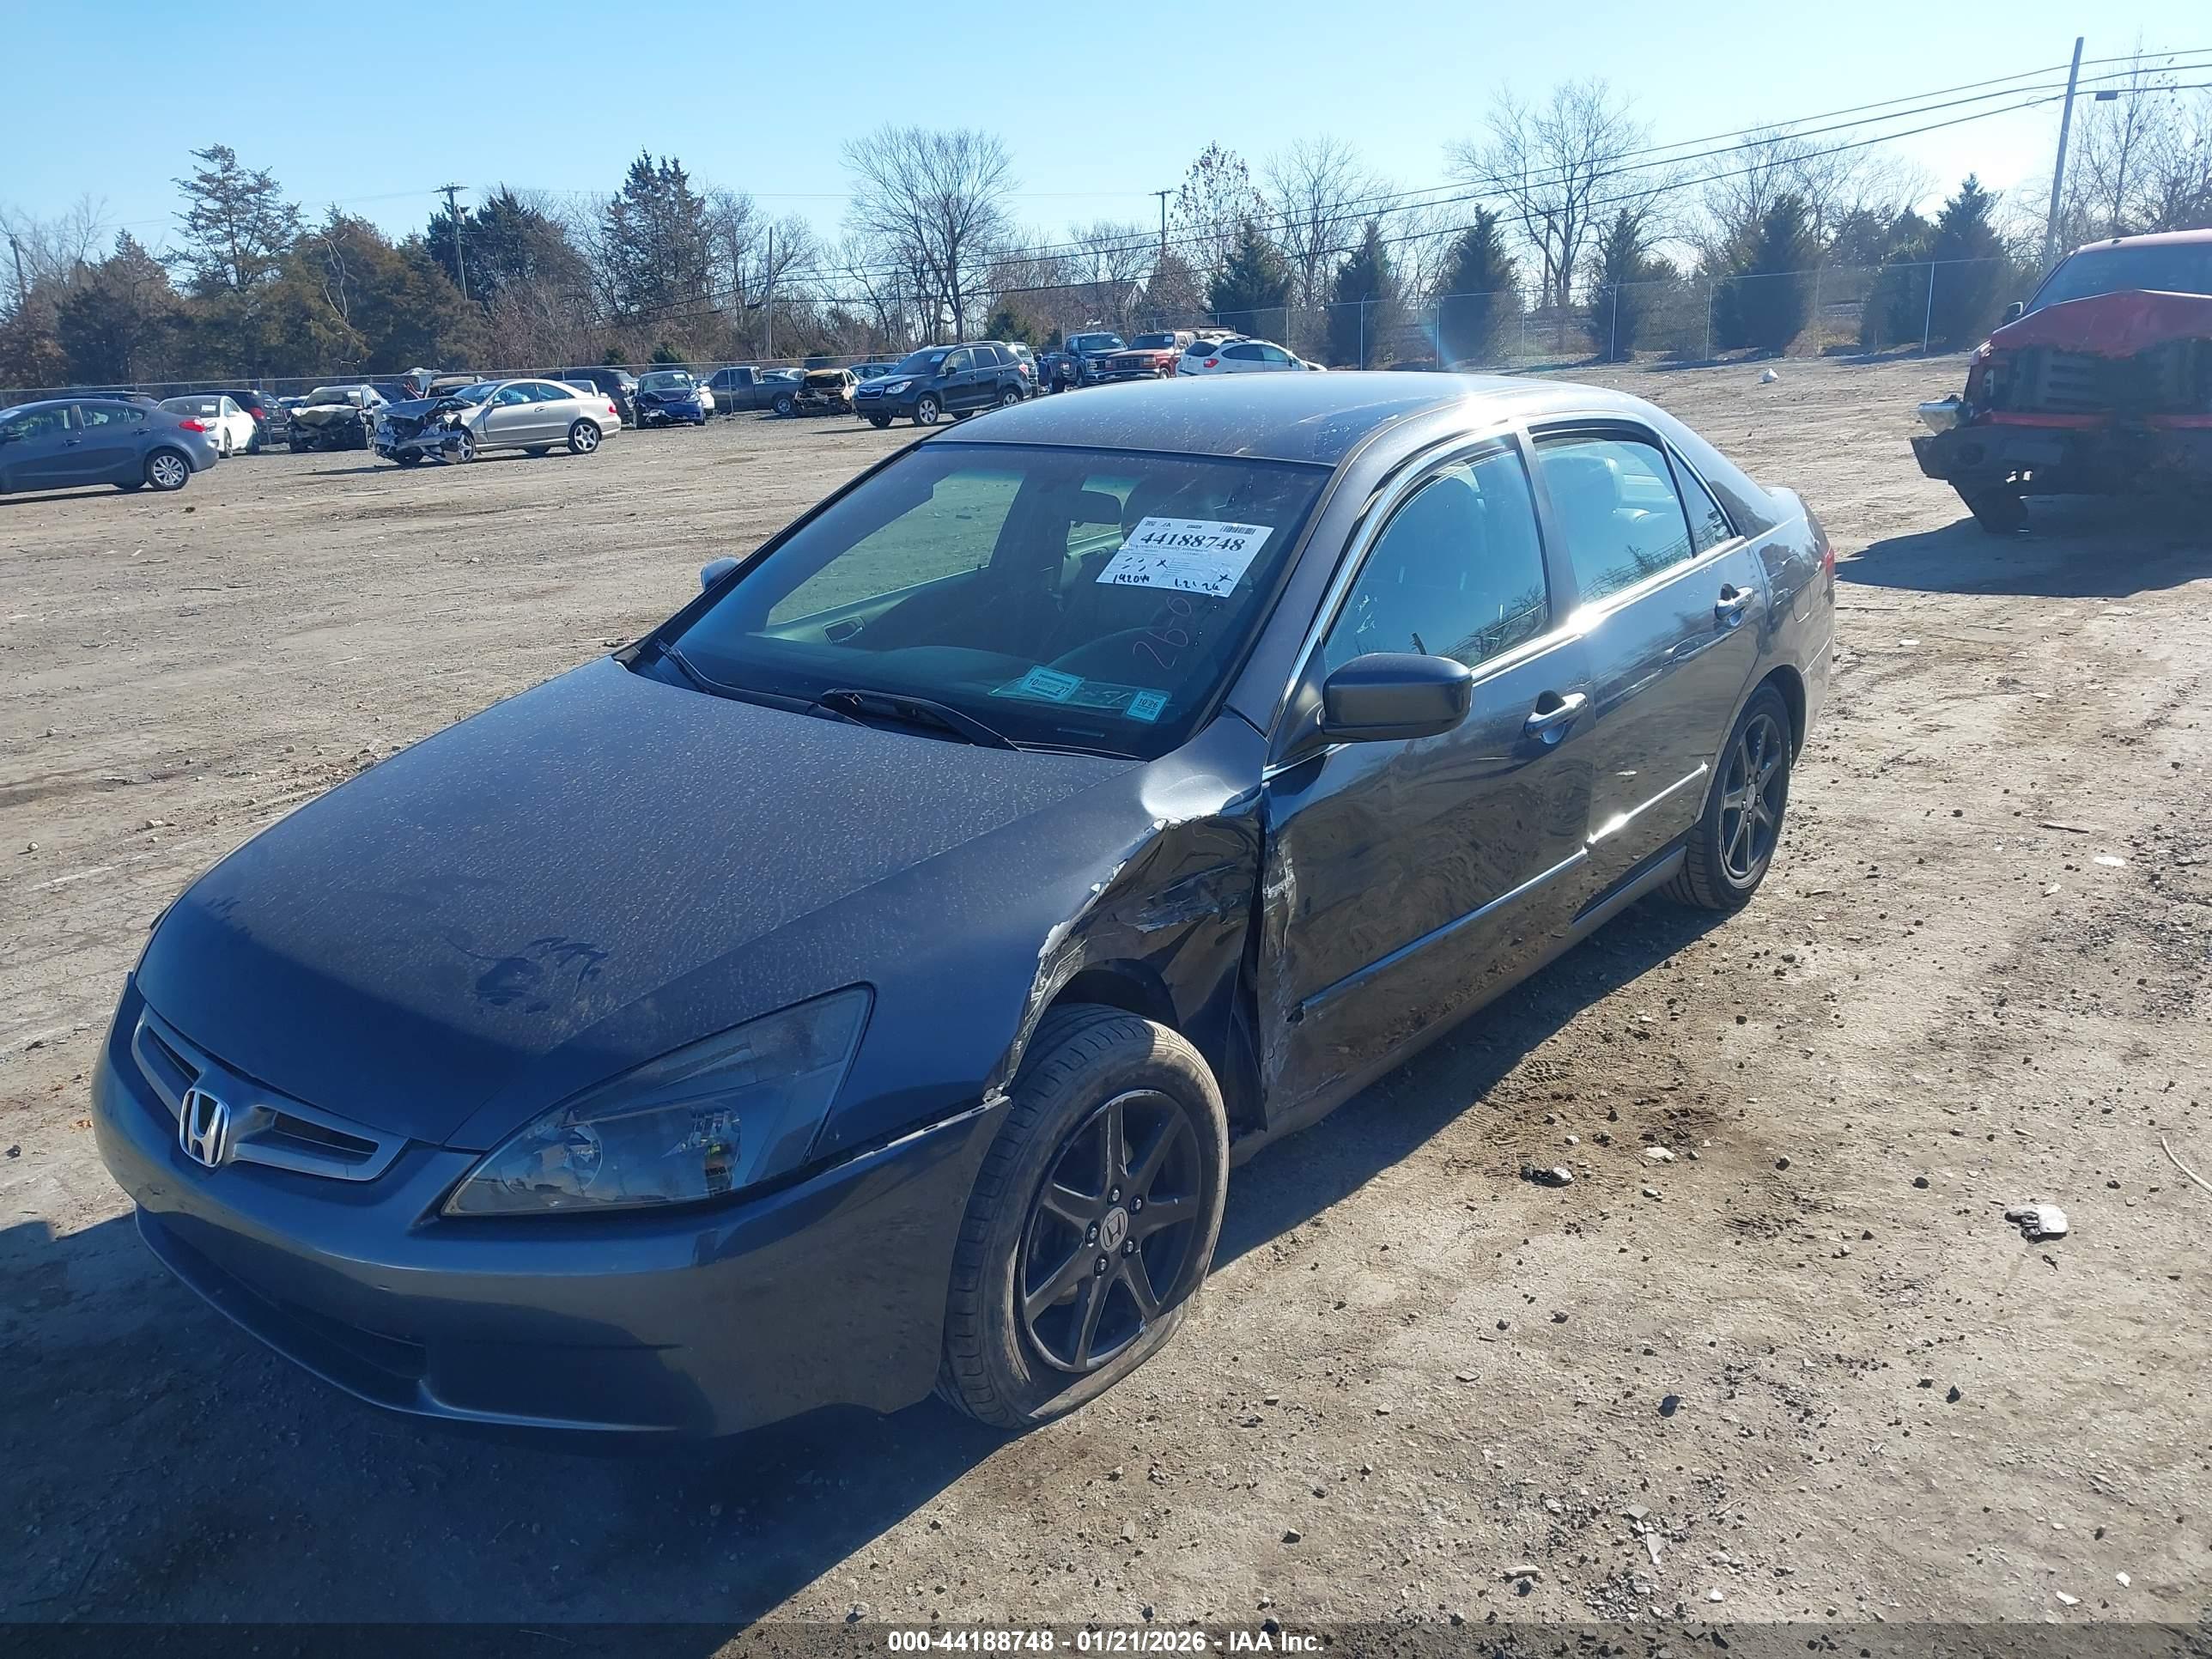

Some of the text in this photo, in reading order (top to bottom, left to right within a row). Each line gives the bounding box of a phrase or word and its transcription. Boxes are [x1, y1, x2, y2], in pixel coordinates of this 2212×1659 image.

[1140, 532, 1245, 551] 44188748
[1028, 678, 1039, 686] 10
[1055, 686, 1070, 695] 27
